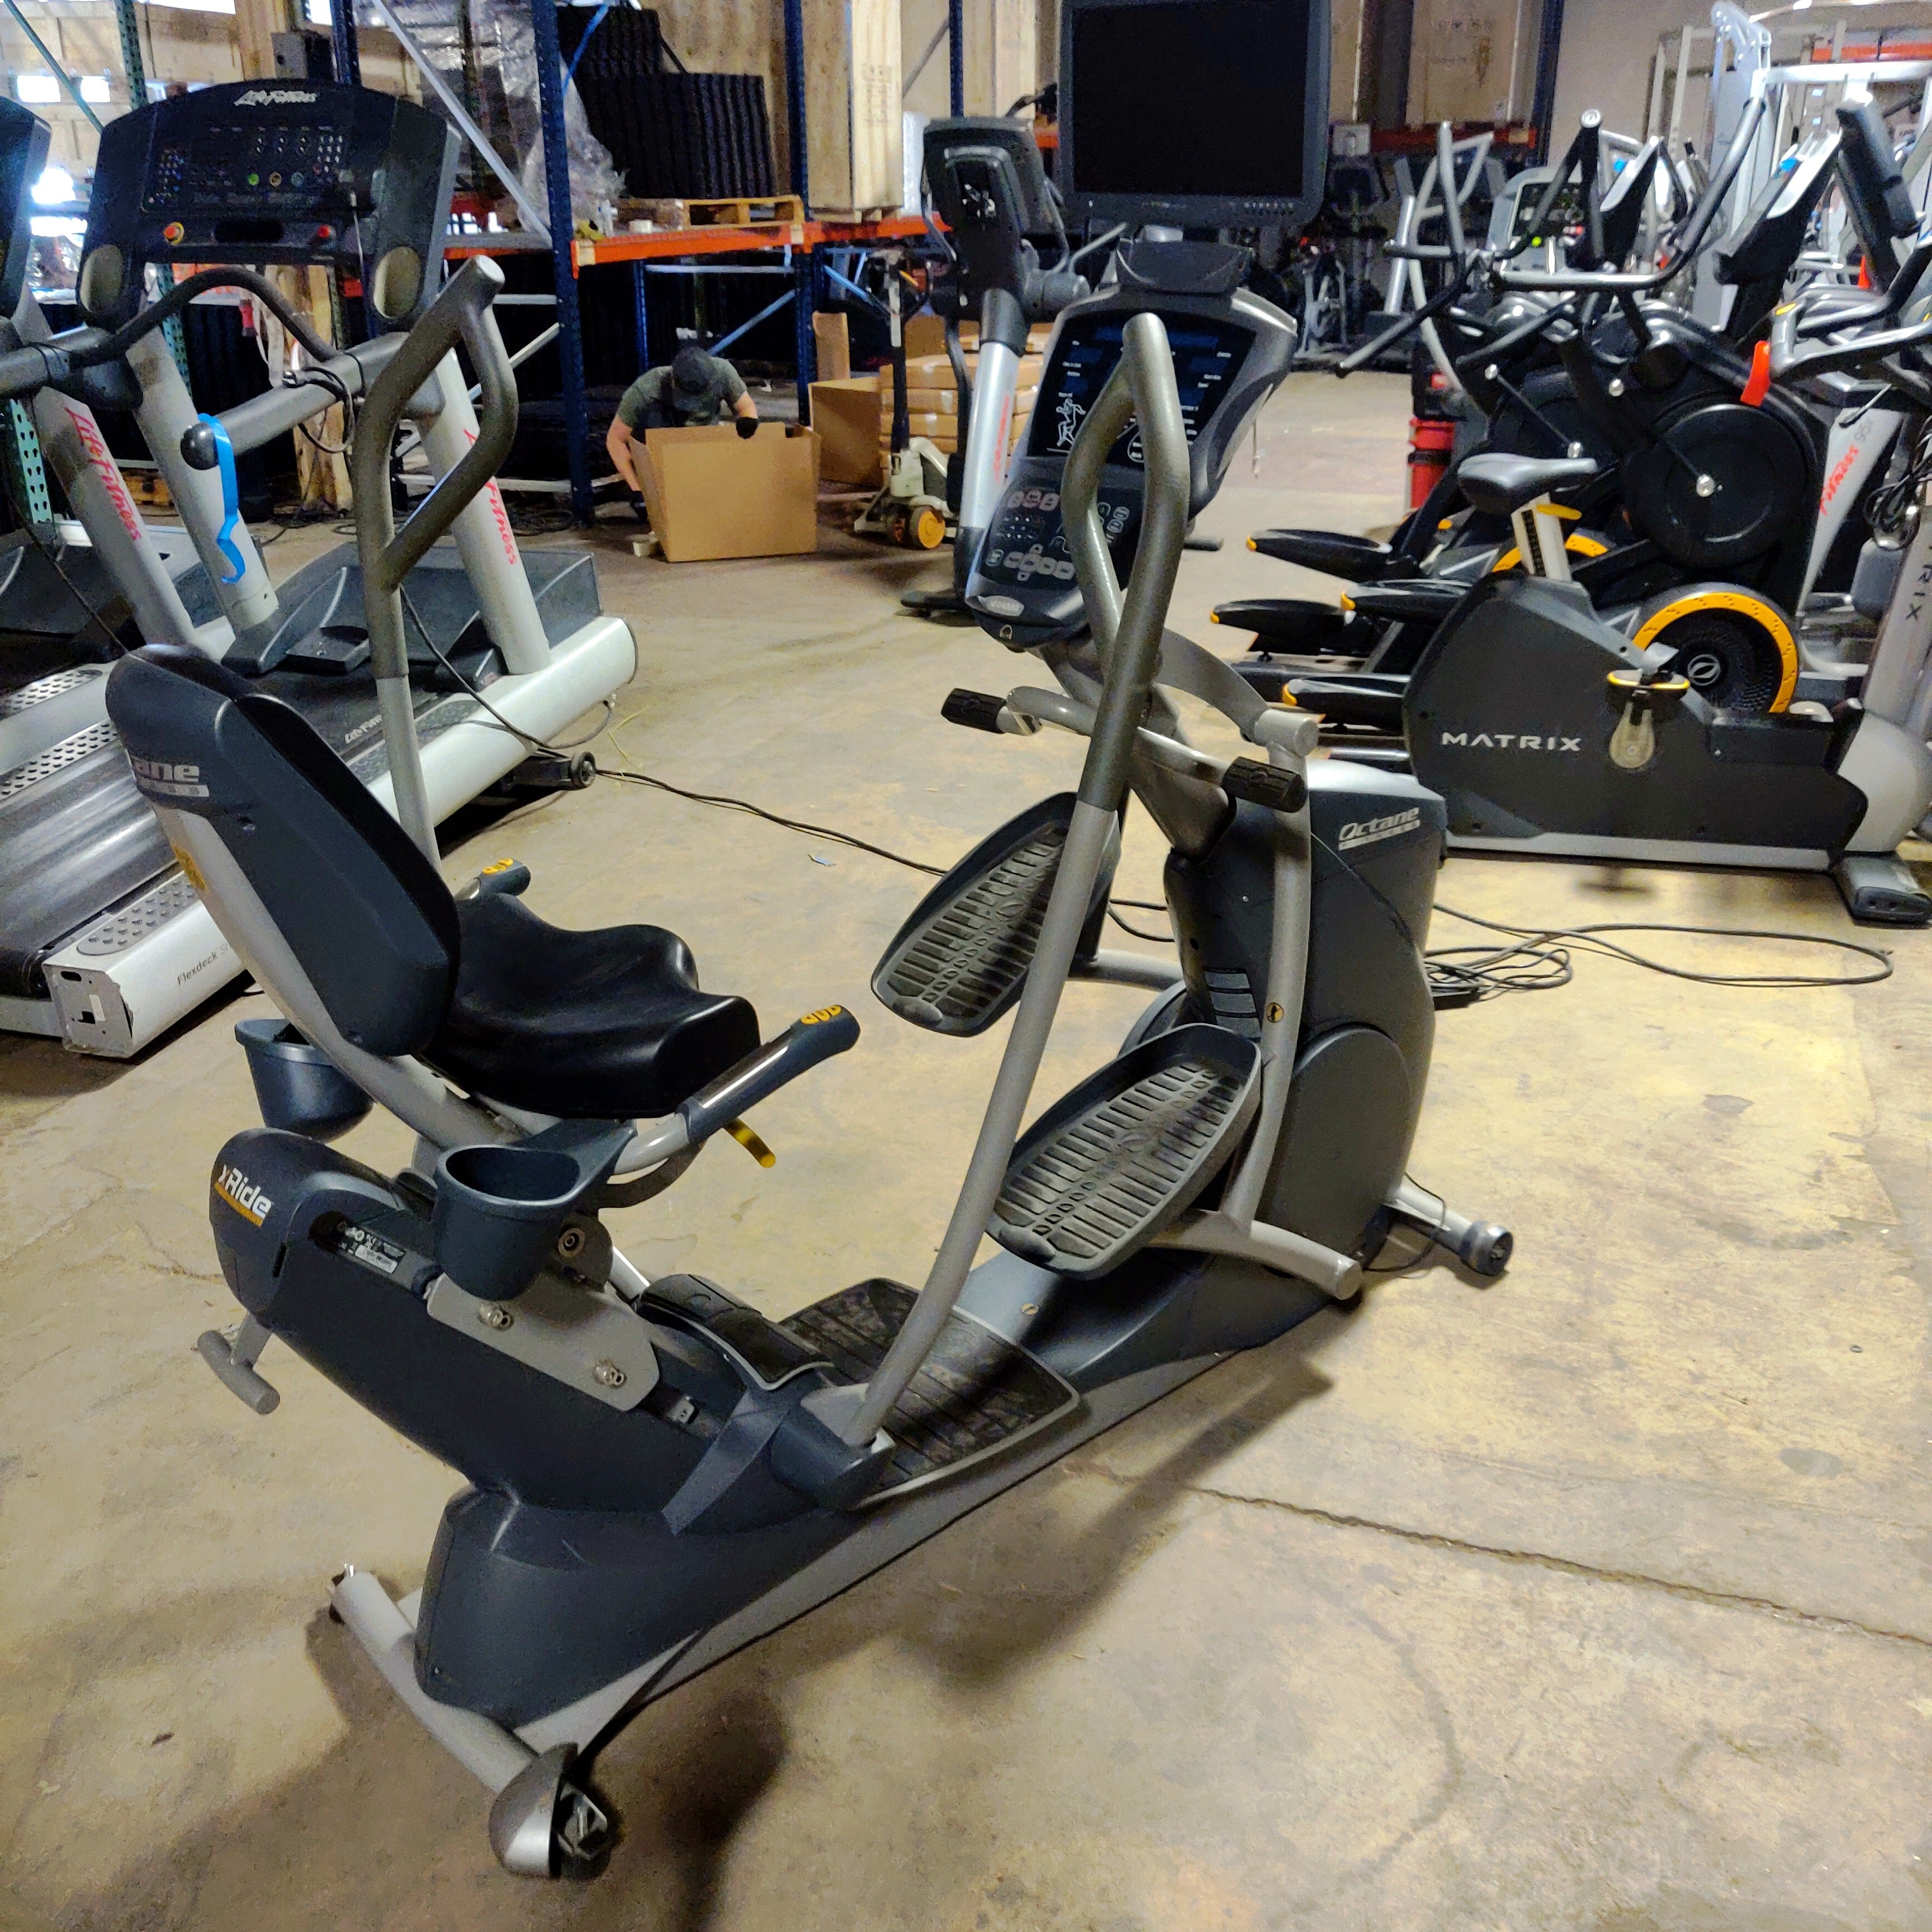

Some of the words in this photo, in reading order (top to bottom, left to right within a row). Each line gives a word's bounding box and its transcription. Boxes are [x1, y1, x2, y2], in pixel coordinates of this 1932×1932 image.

[1442, 732, 1581, 751] MATRIX
[130, 755, 200, 783] ane
[1338, 807, 1420, 841] Octane
[177, 951, 217, 987] Flexdeck
